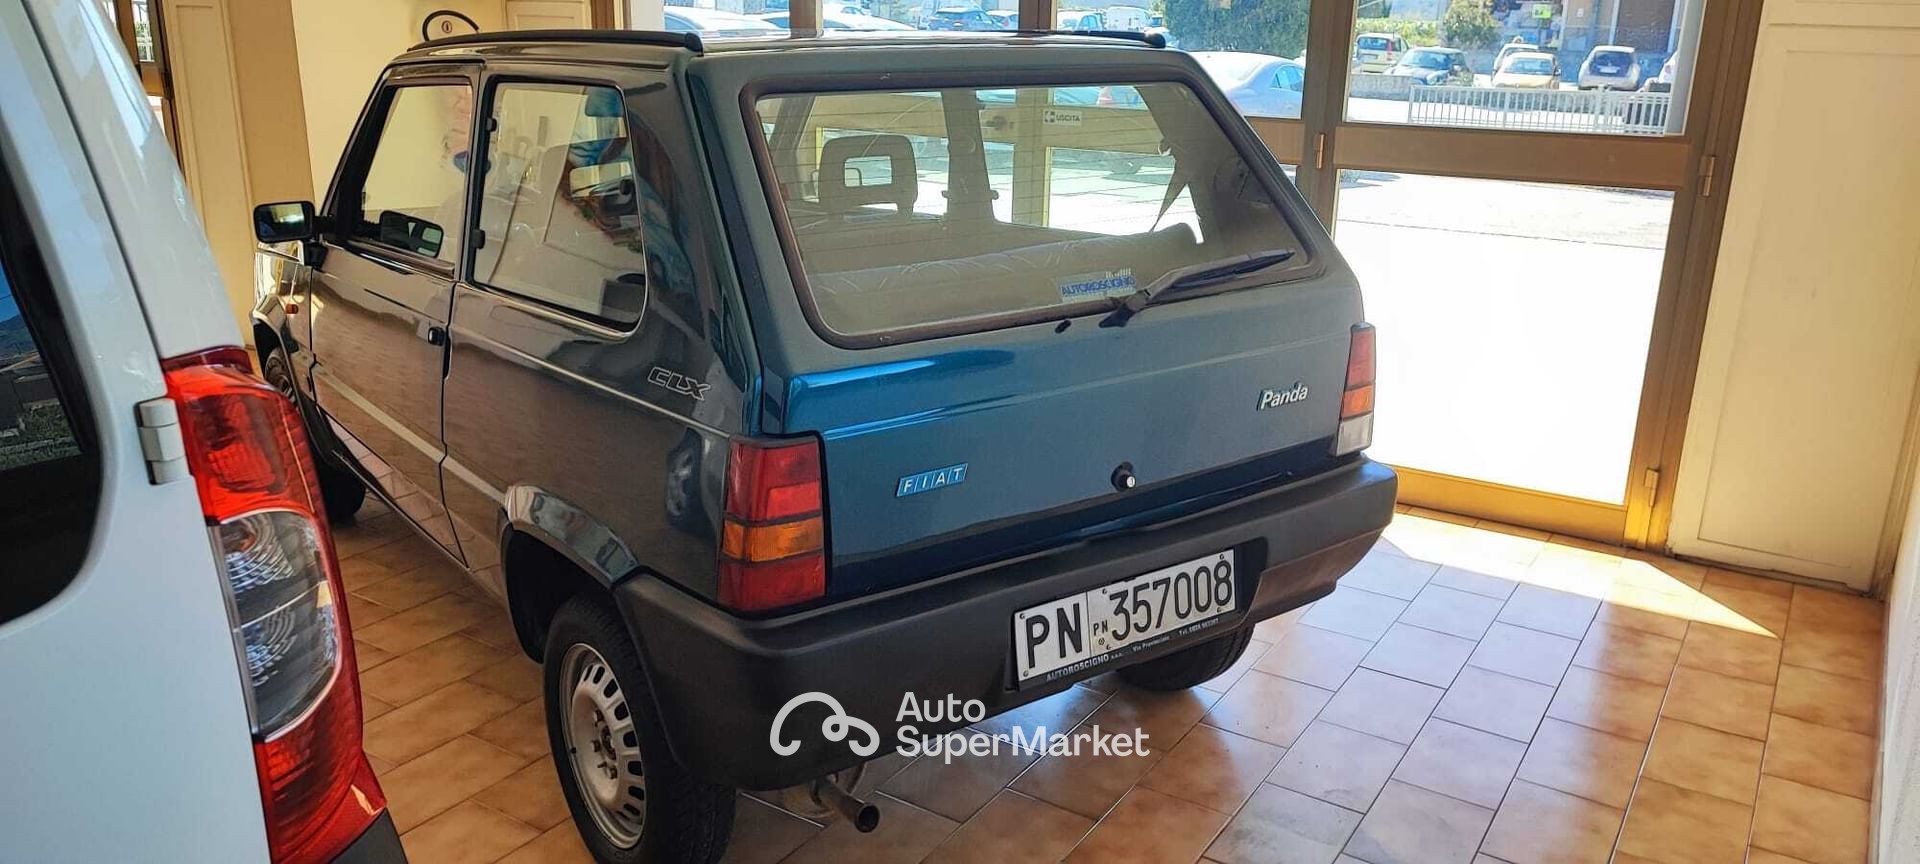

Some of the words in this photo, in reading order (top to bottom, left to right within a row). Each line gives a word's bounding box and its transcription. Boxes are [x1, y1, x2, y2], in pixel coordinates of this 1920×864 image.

[1055, 113, 1081, 122] USCITA
[647, 366, 711, 401] CLX
[1260, 382, 1308, 410] Panda
[903, 467, 963, 493] FIAT
[1025, 602, 1083, 669] PN
[1093, 619, 1108, 636] PN
[1110, 560, 1233, 641] 357008
[1046, 654, 1109, 682] AUTOROSCIGNO
